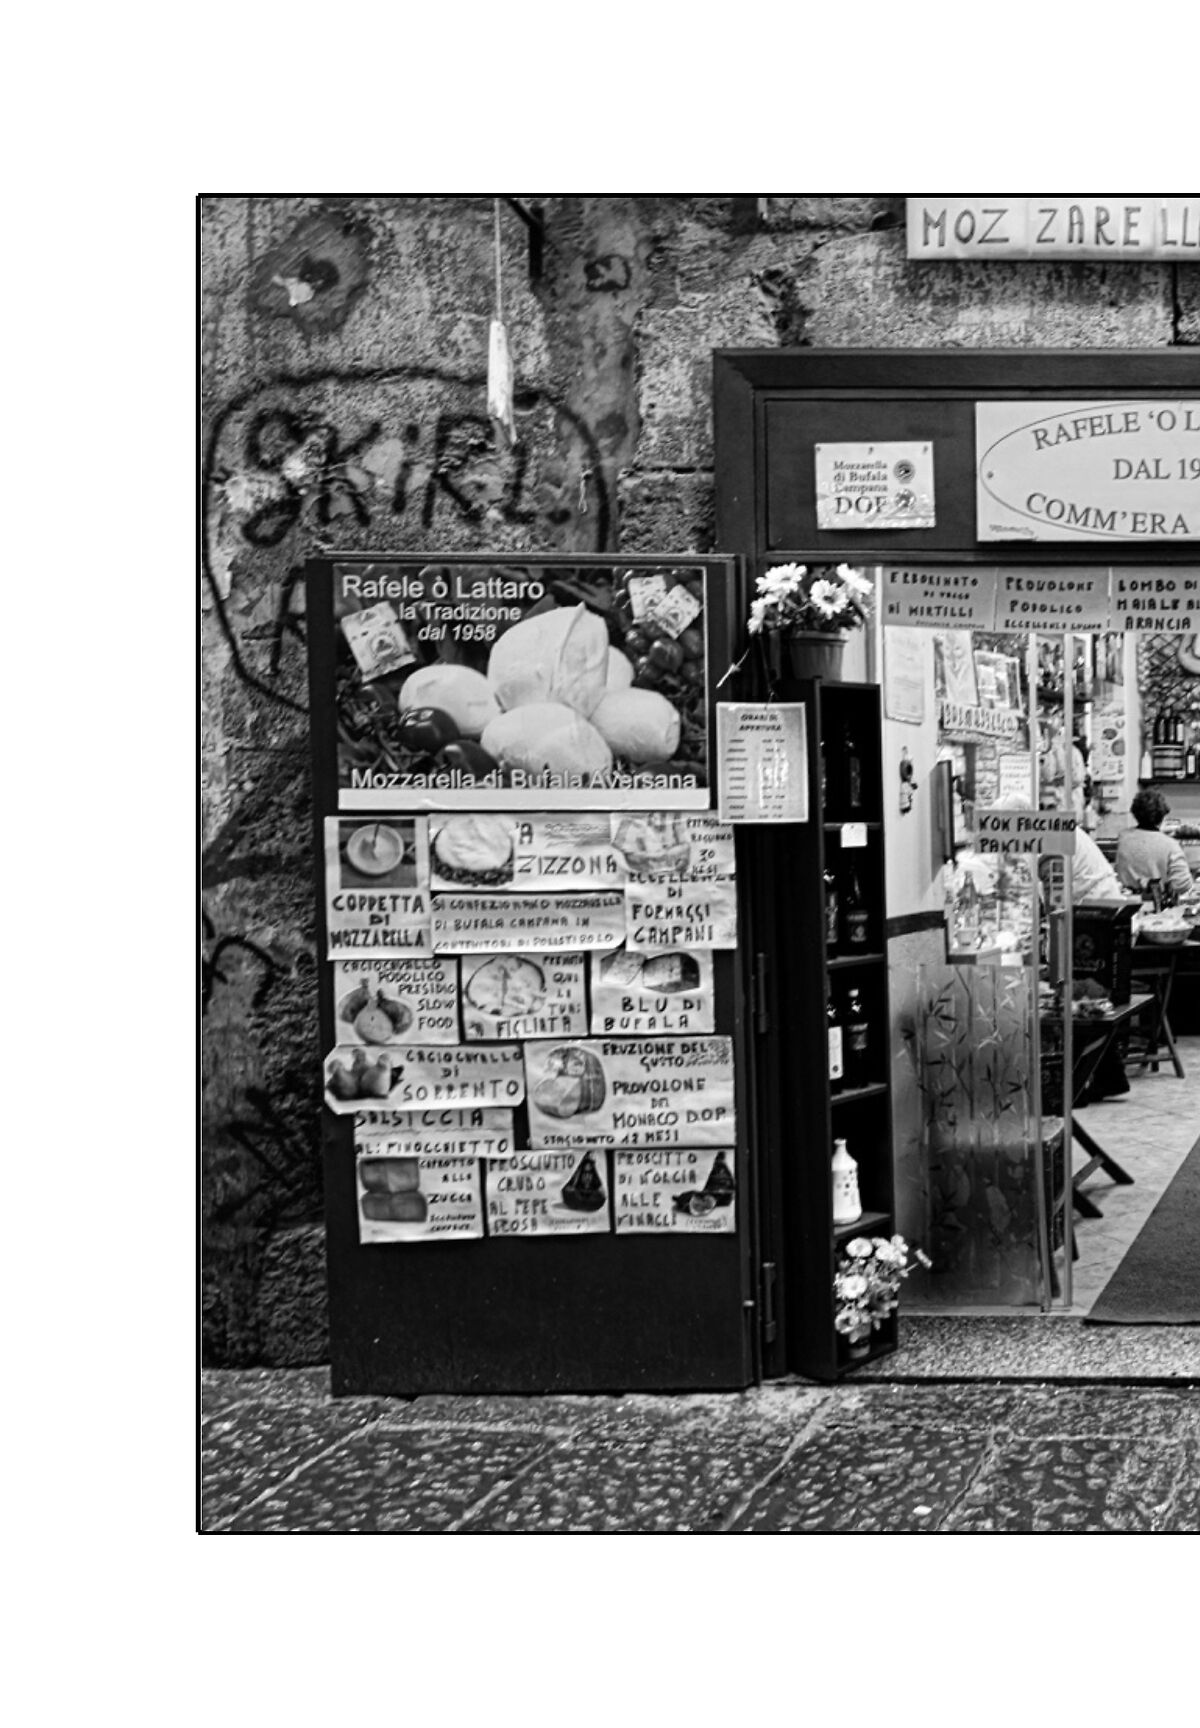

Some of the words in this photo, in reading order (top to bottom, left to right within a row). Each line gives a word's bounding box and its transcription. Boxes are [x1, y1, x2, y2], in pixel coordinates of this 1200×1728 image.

[1032, 410, 1141, 451] RAFELE
[1113, 458, 1170, 480] DAL
[343, 575, 424, 599] Rafele
[456, 576, 545, 600] Lattaro
[1118, 579, 1176, 593] LOMBO
[1184, 579, 1198, 590] DI
[400, 603, 416, 621] la
[423, 603, 522, 622] Tradizione
[908, 604, 974, 618] MIRTILLI
[1125, 615, 1191, 631] ARANCIA
[418, 624, 446, 642] dal
[452, 624, 497, 642] 1958
[352, 769, 479, 790] Mozzarella
[483, 769, 503, 790] di
[511, 769, 585, 790] Bufala
[589, 770, 697, 790] Aversana
[979, 815, 1011, 832] NON
[1016, 816, 1077, 833] FACCIAMO
[980, 837, 1043, 854] PANINI
[516, 854, 618, 876] ZIZZONA
[667, 887, 682, 898] DI
[332, 894, 425, 914] COPPETTA
[369, 914, 390, 926] DI
[631, 904, 711, 923] FORMAGGI
[434, 919, 447, 932] DI
[454, 918, 504, 932] BUFALA
[330, 929, 425, 949] MOZZARELLA
[634, 925, 714, 944] CAMPANI
[416, 999, 455, 1012] SLOW
[622, 997, 667, 1013] BLU
[682, 999, 702, 1012] DI
[418, 1016, 454, 1031] FOOD
[603, 1014, 689, 1031] BUFALA
[681, 1042, 708, 1055] DEL
[612, 1077, 706, 1095] PROVOLONE
[612, 1111, 679, 1129] MONACO
[686, 1107, 726, 1123] DOP
[645, 1130, 679, 1143] MESI
[497, 1176, 546, 1192] CRUDO
[618, 1174, 633, 1185] DI
[621, 1191, 661, 1208] ALLE
[489, 1201, 508, 1216] AL
